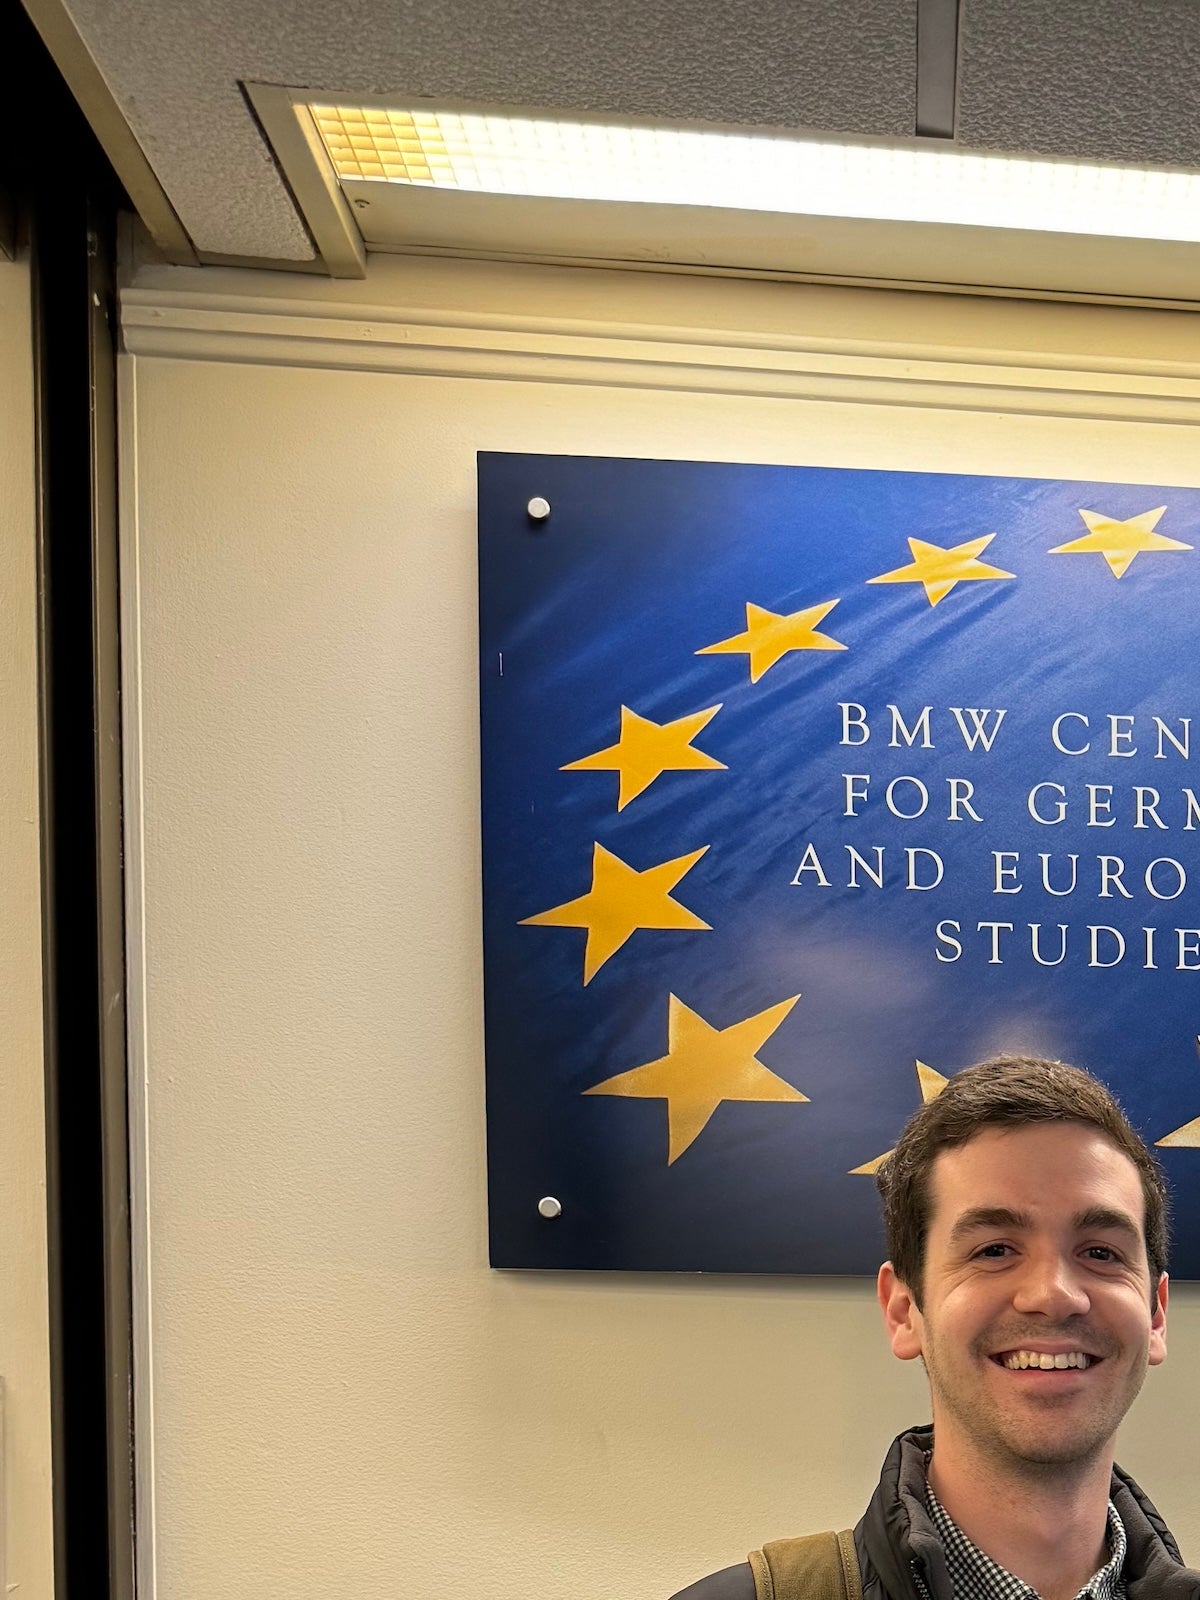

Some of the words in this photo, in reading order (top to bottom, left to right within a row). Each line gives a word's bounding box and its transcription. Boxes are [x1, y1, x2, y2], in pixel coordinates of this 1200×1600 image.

[838, 701, 1008, 753] BMW
[841, 773, 984, 823] FOR
[789, 842, 945, 891] AND
